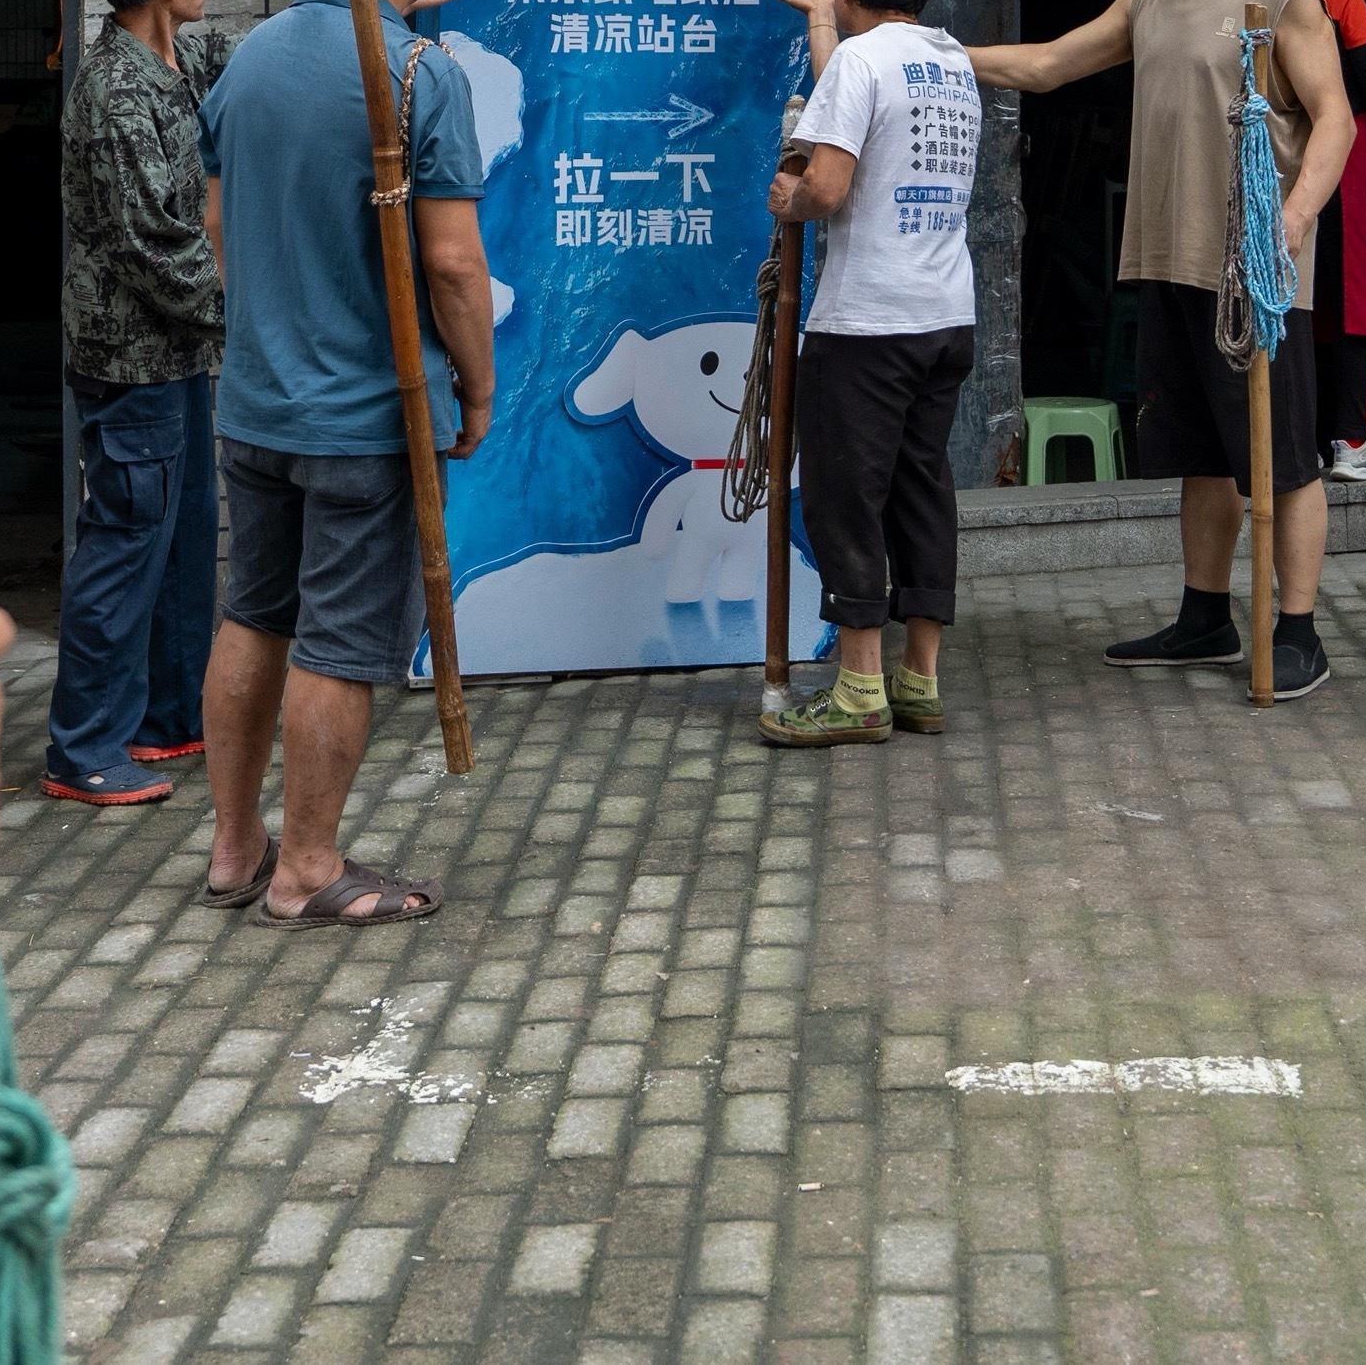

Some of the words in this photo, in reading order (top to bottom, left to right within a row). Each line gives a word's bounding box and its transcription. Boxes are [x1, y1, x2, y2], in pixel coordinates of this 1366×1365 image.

[550, 13, 717, 54] 清凉站台
[902, 61, 943, 85] 迪驰
[923, 105, 958, 123] 广告衫
[924, 123, 959, 140] 广告帽
[925, 141, 959, 157] 酒店服
[554, 152, 715, 203] 拉一下
[895, 189, 952, 201] 朝天门旗舰店
[898, 206, 923, 220] 急单
[555, 208, 713, 248] 即刻清凉
[897, 221, 921, 234] 专线
